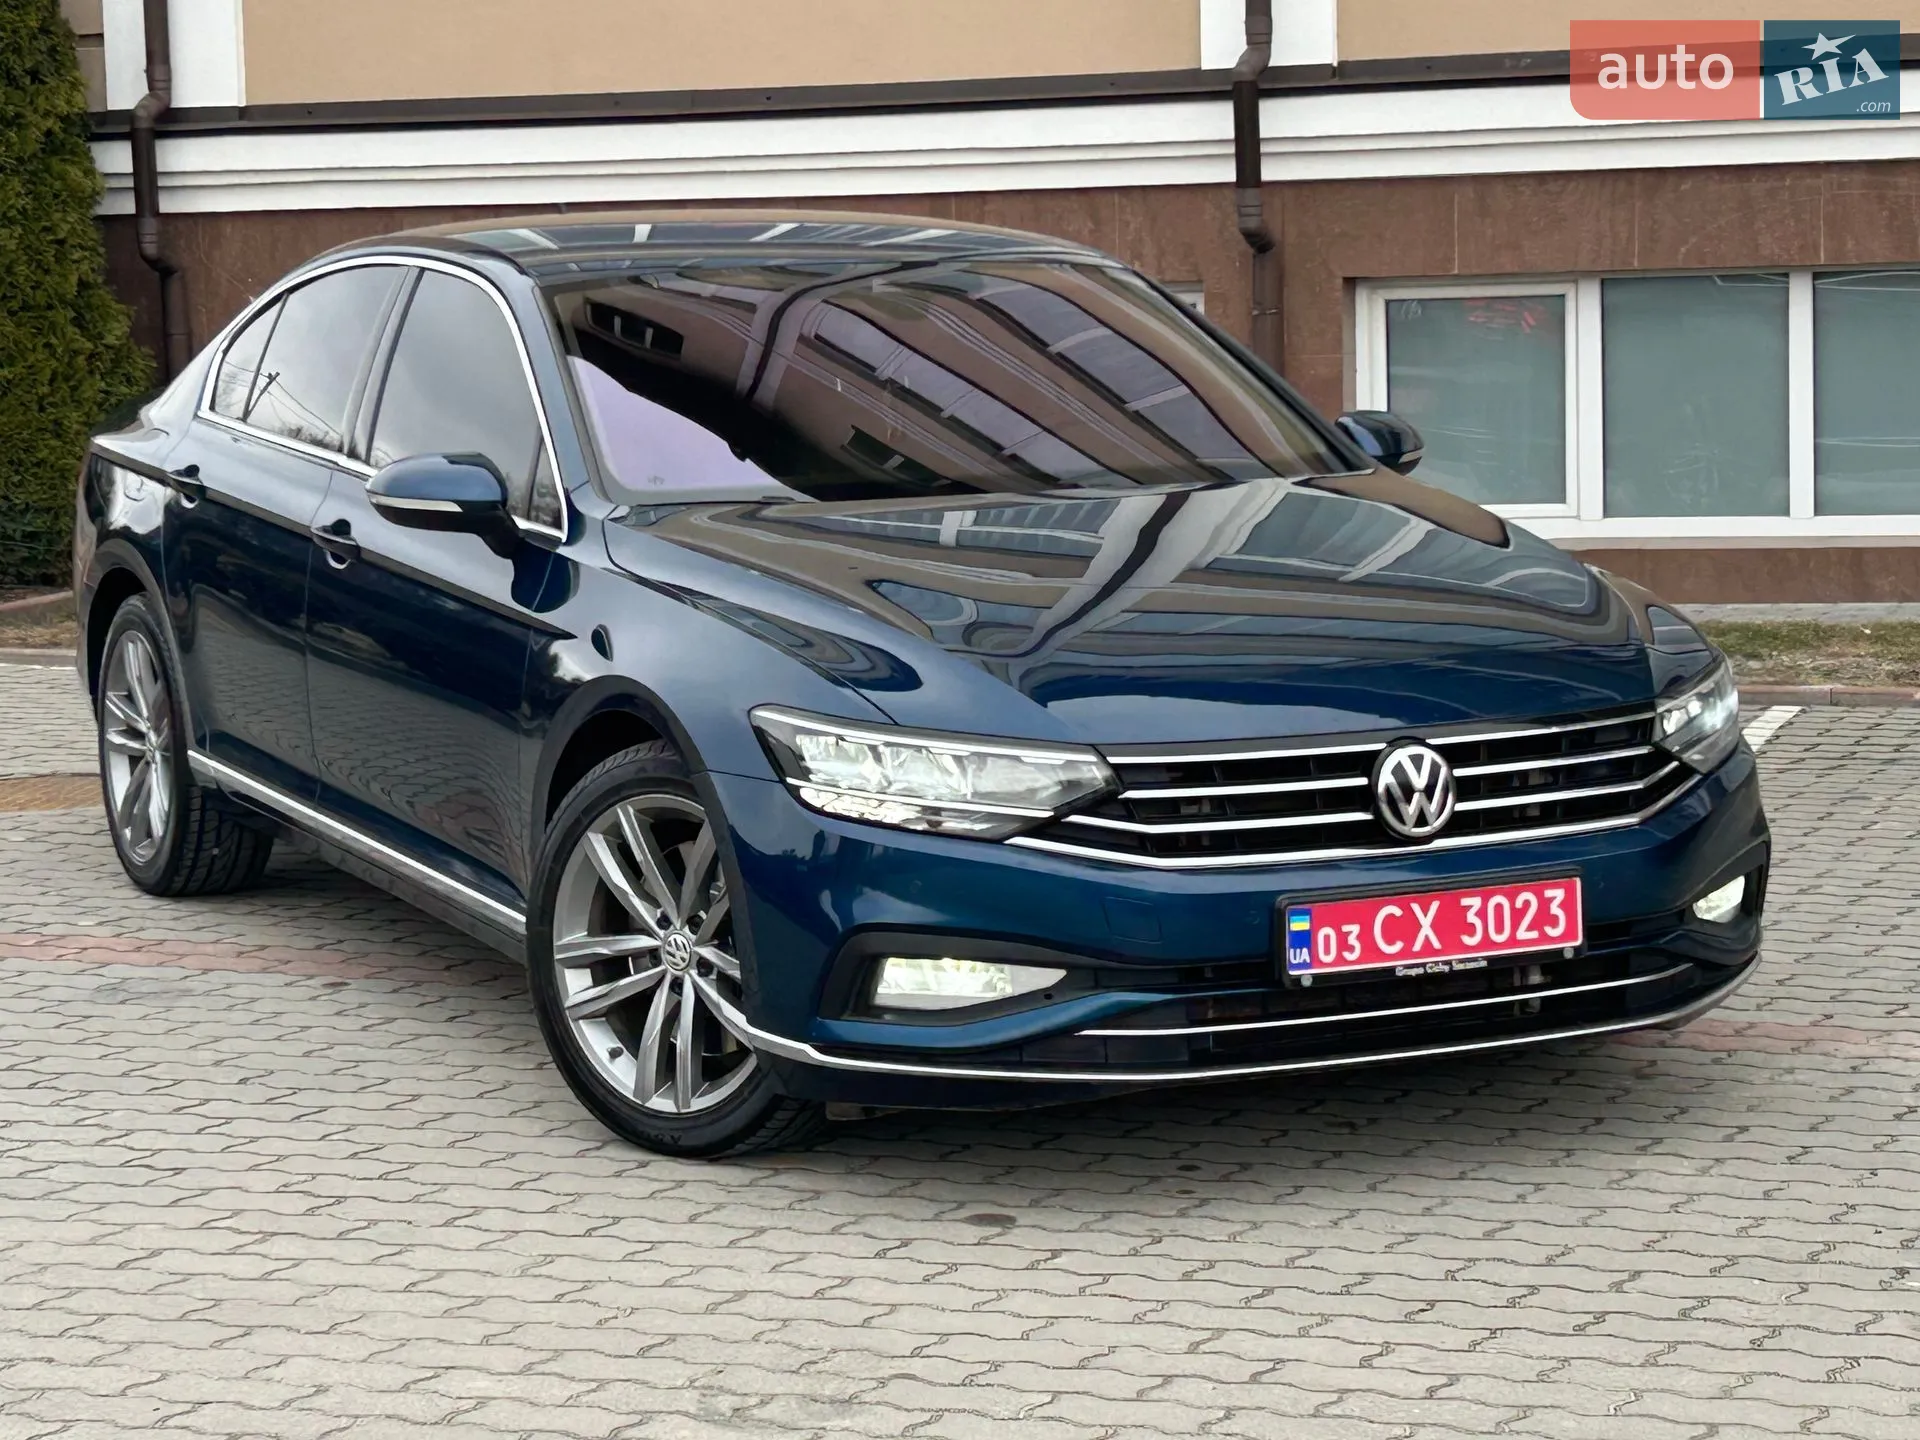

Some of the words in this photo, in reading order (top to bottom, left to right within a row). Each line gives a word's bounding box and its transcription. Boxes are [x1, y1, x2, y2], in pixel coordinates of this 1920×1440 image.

[1380, 748, 1453, 834] VW
[1289, 948, 1310, 964] UA
[1317, 924, 1361, 964] 03
[1373, 901, 1442, 954] CX
[1460, 888, 1567, 946] 3023
